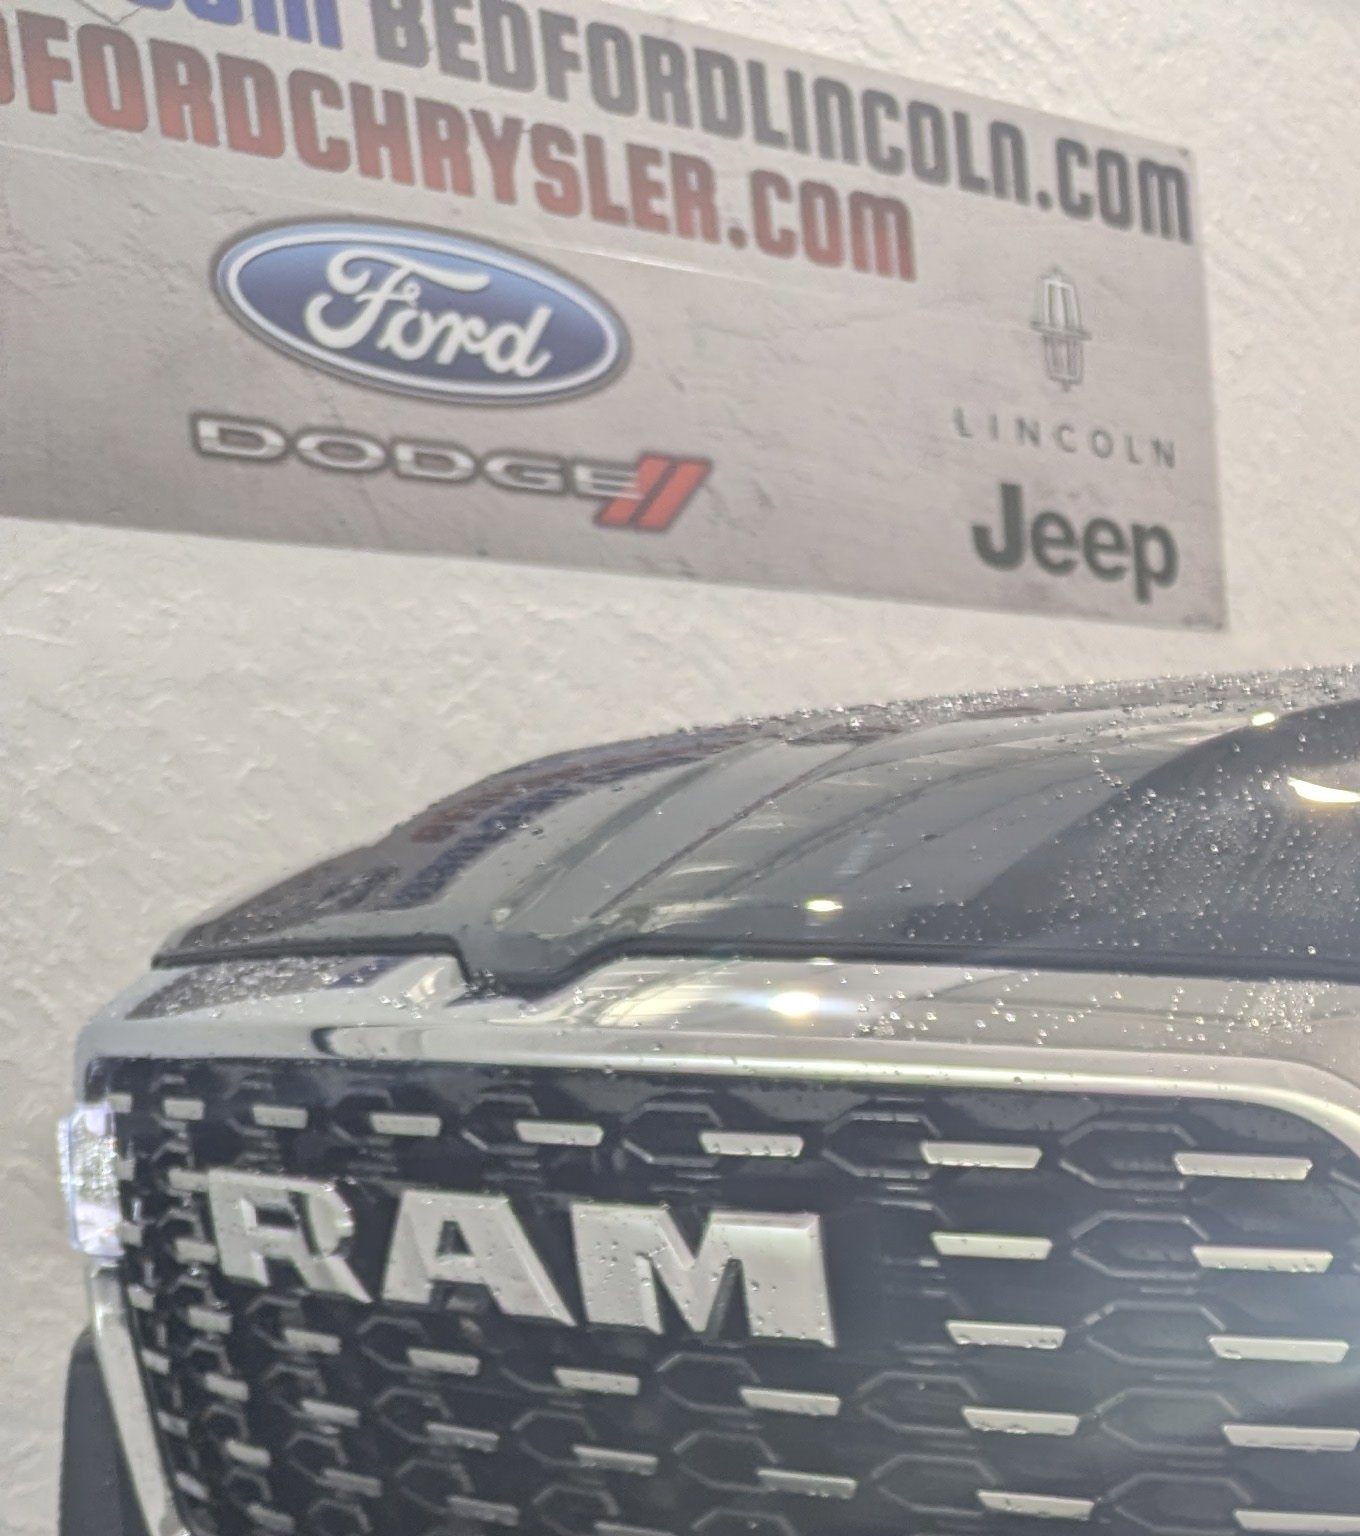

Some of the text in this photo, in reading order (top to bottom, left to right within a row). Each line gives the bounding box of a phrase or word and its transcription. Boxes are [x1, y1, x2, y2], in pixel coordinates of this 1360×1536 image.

[0, 9, 917, 283] FORDCHRYSLER.COM
[304, 246, 555, 379] Ford
[191, 411, 645, 502] DODGE
[953, 405, 1178, 470] LINCOLN
[971, 482, 1179, 605] Jeep
[208, 1167, 836, 1349] RAM
